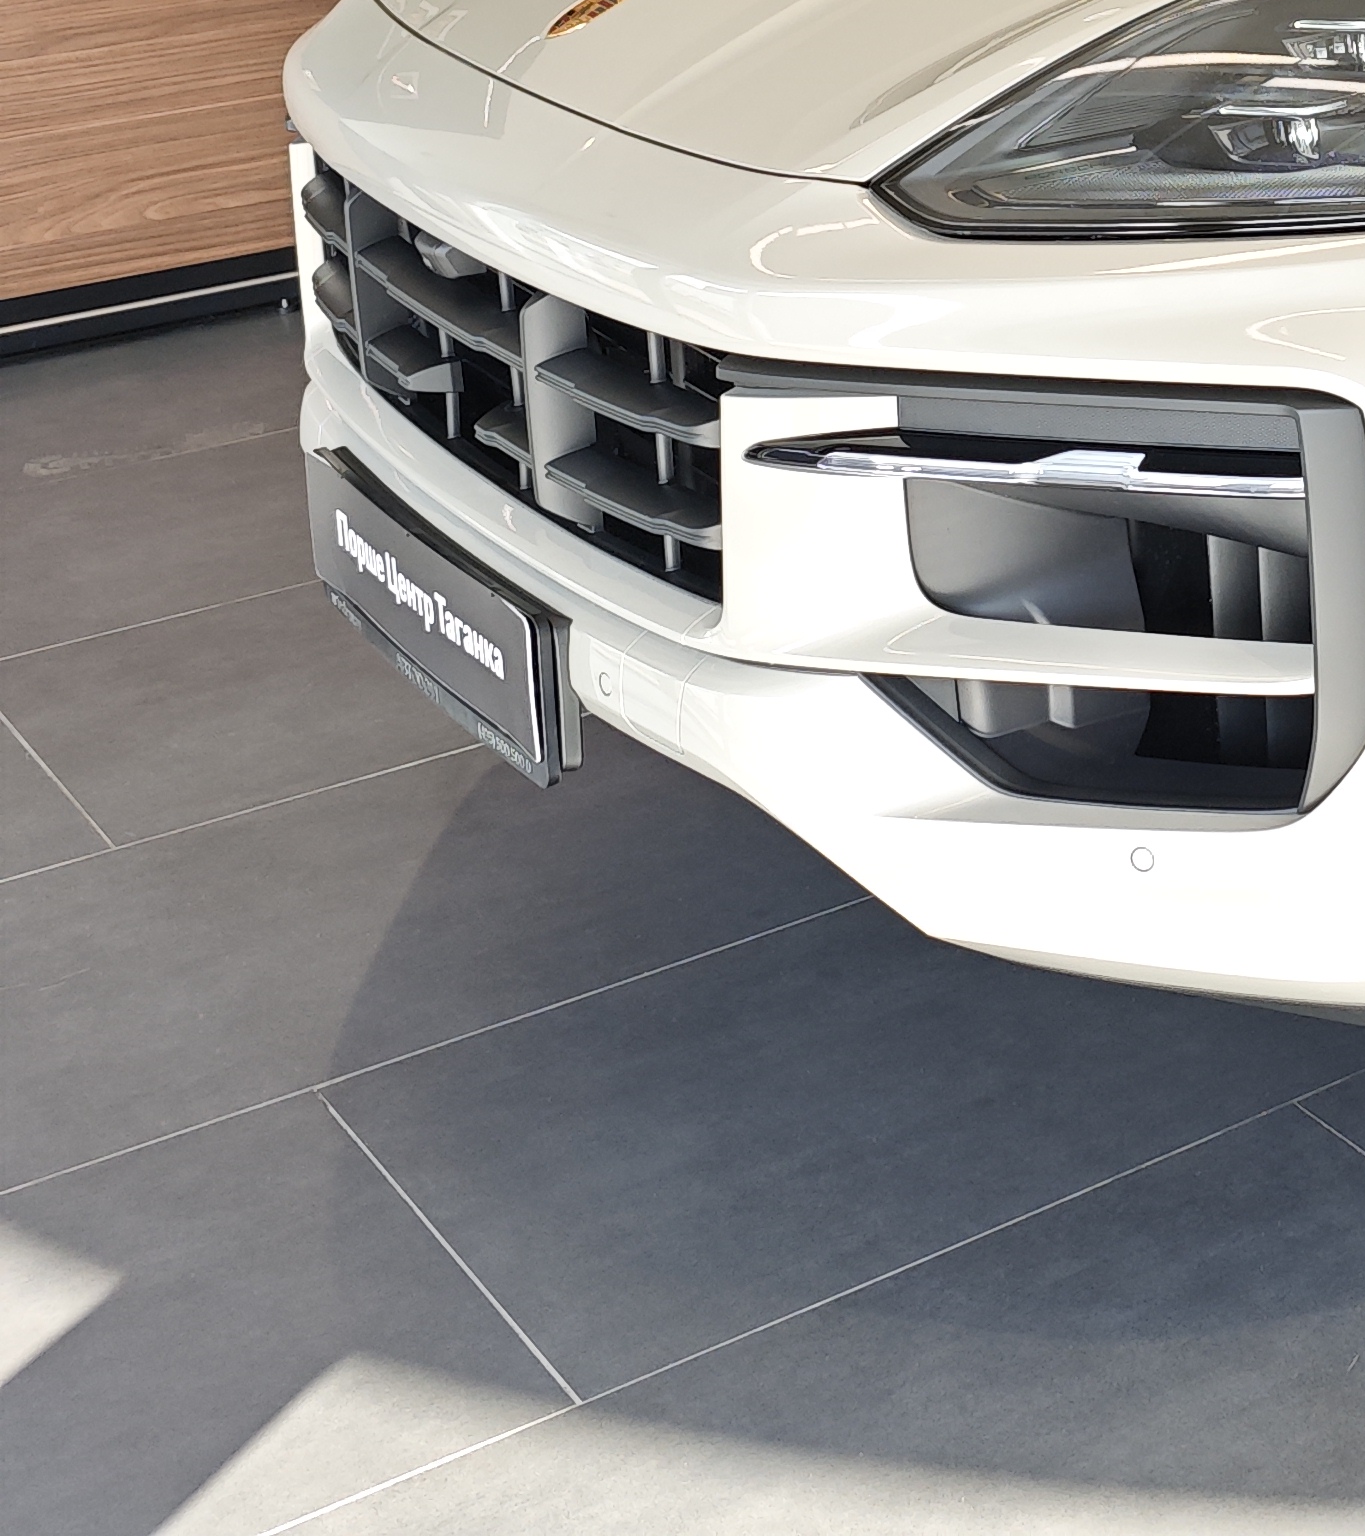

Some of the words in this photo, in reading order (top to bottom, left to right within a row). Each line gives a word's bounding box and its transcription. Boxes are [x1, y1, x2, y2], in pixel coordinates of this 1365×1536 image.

[335, 508, 386, 583] Порше
[384, 551, 435, 633] Центр
[433, 591, 505, 681] Таганка
